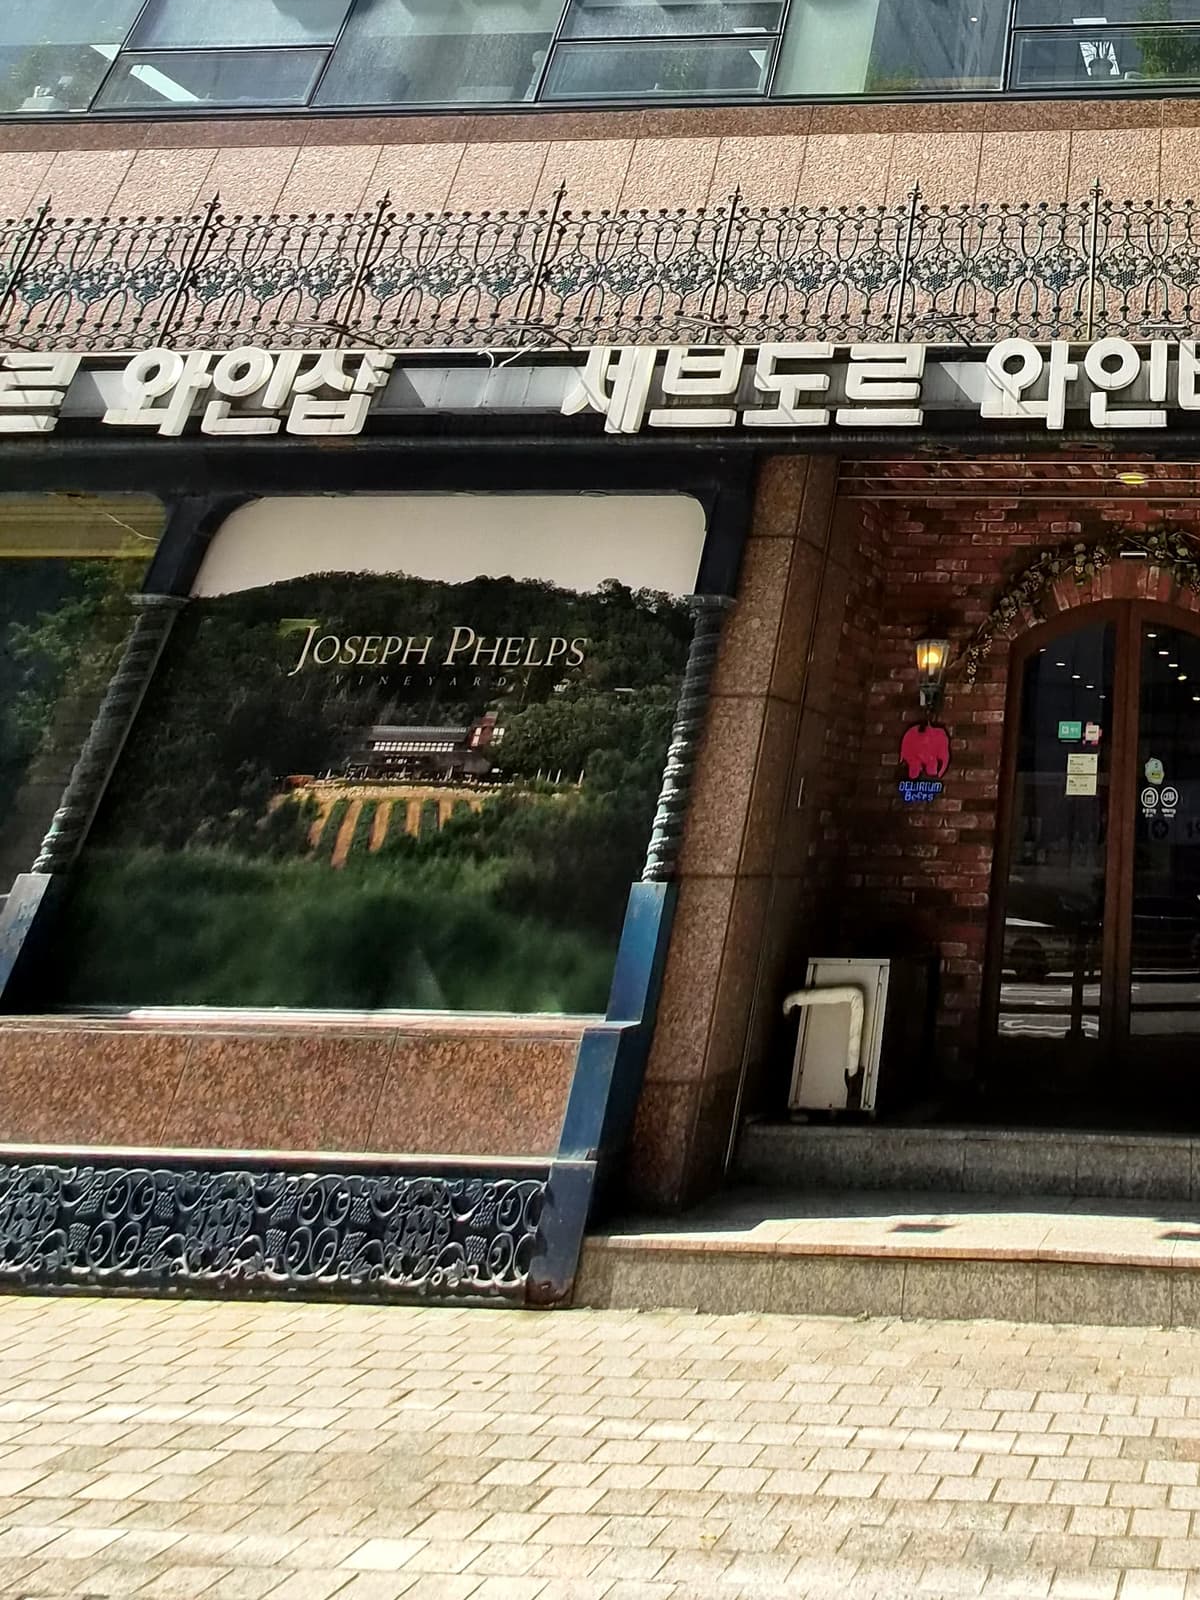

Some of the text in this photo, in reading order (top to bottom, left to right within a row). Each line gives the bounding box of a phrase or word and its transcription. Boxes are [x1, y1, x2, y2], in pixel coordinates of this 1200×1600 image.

[102, 346, 395, 436] 와인샵
[559, 342, 927, 434] 세브도르
[287, 625, 588, 676] JOSEPH PHELPS
[334, 674, 532, 688] VINEYARDS
[899, 781, 942, 792] DELIRIUM
